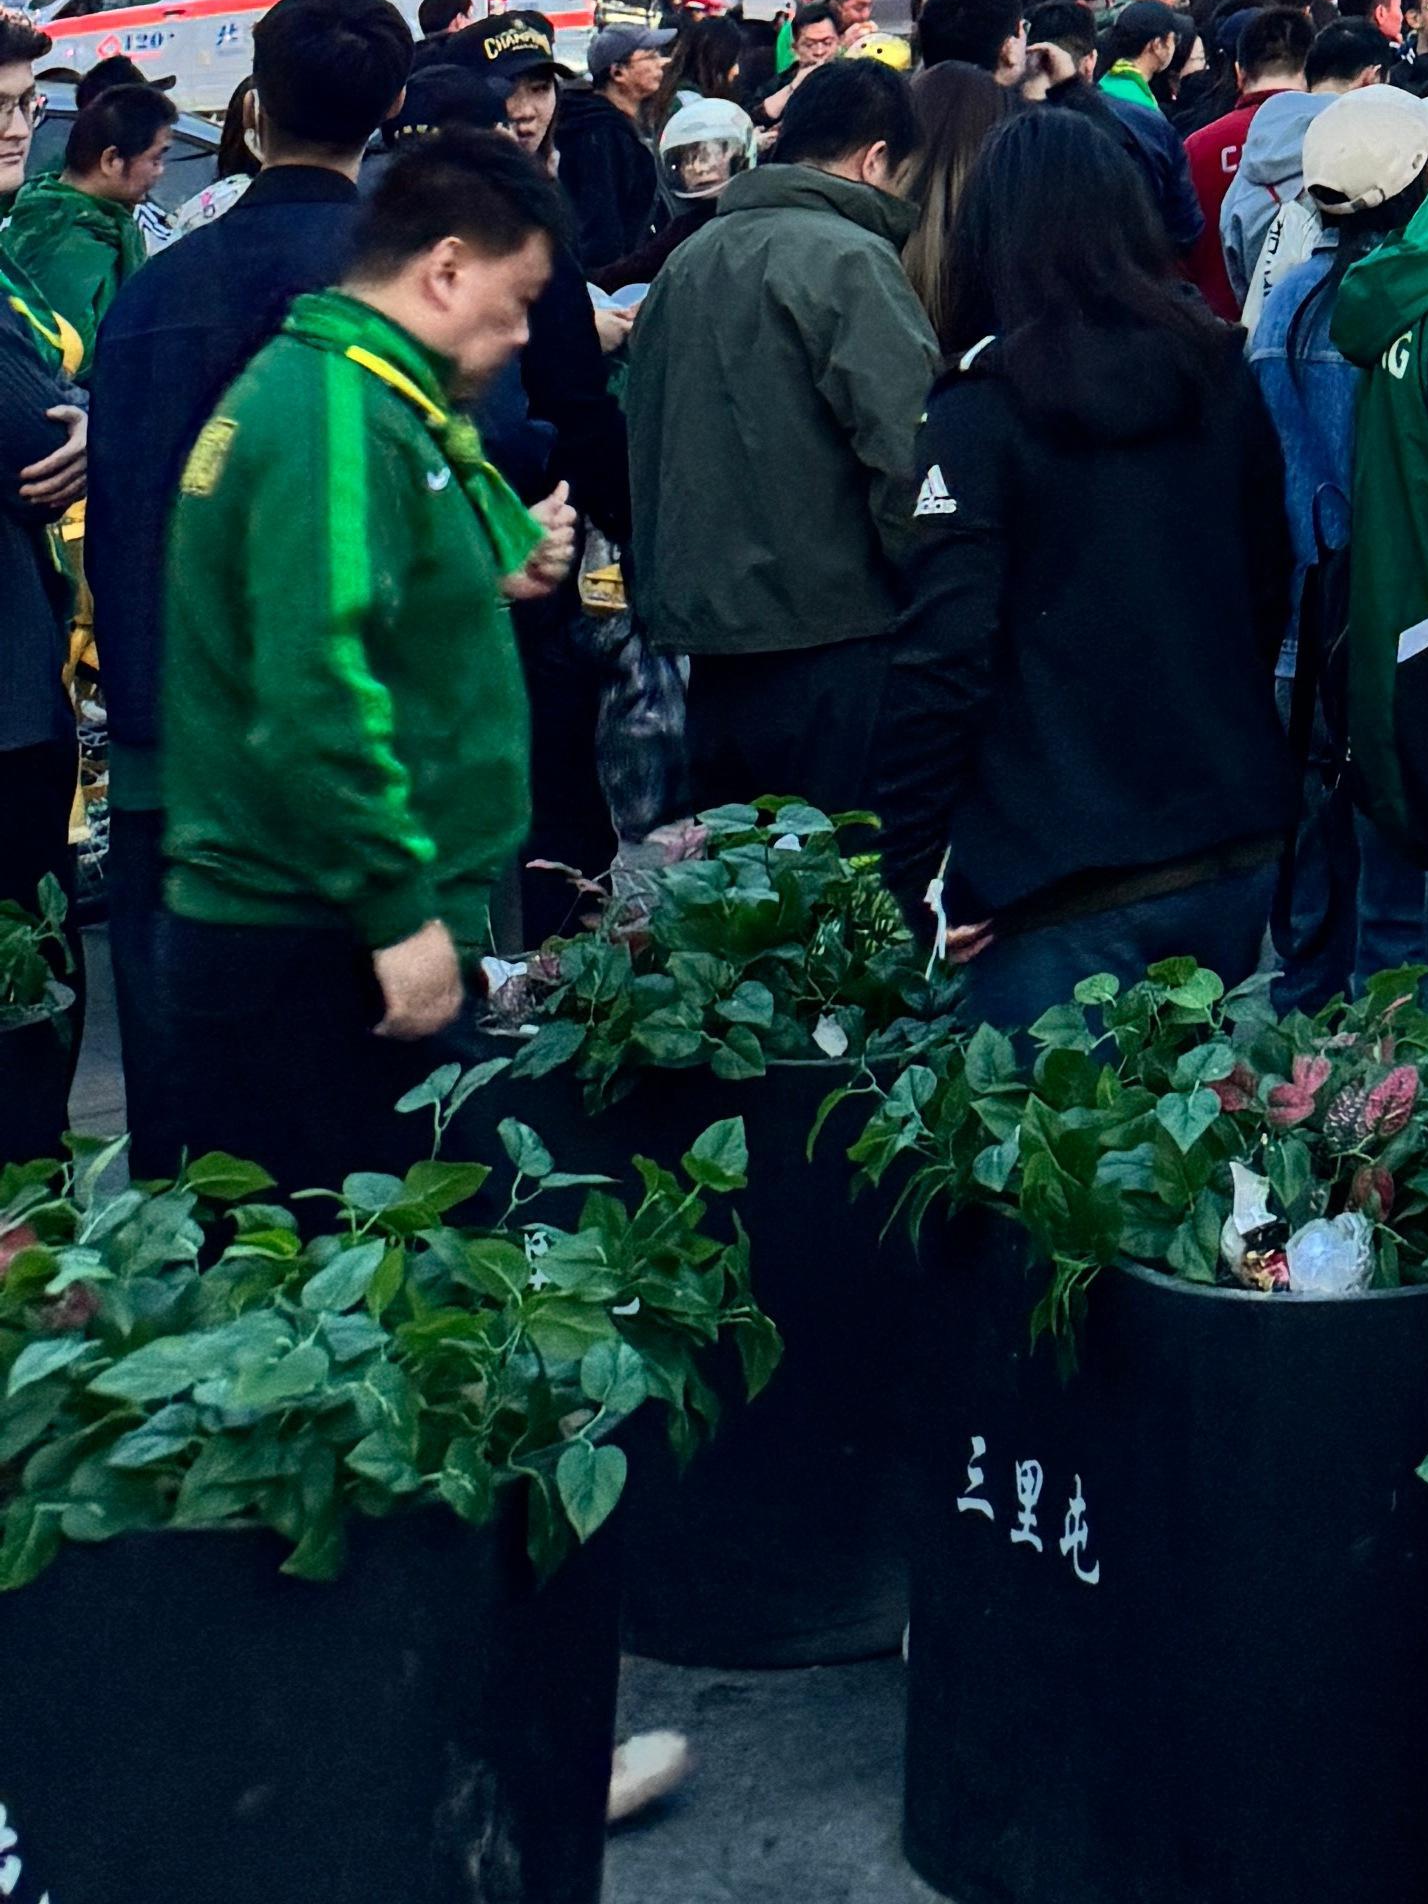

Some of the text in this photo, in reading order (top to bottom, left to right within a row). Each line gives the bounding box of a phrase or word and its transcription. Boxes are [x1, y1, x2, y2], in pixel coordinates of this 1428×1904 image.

[124, 32, 164, 51] 120
[1381, 330, 1412, 379] G
[957, 1435, 1100, 1585] 三里屯
